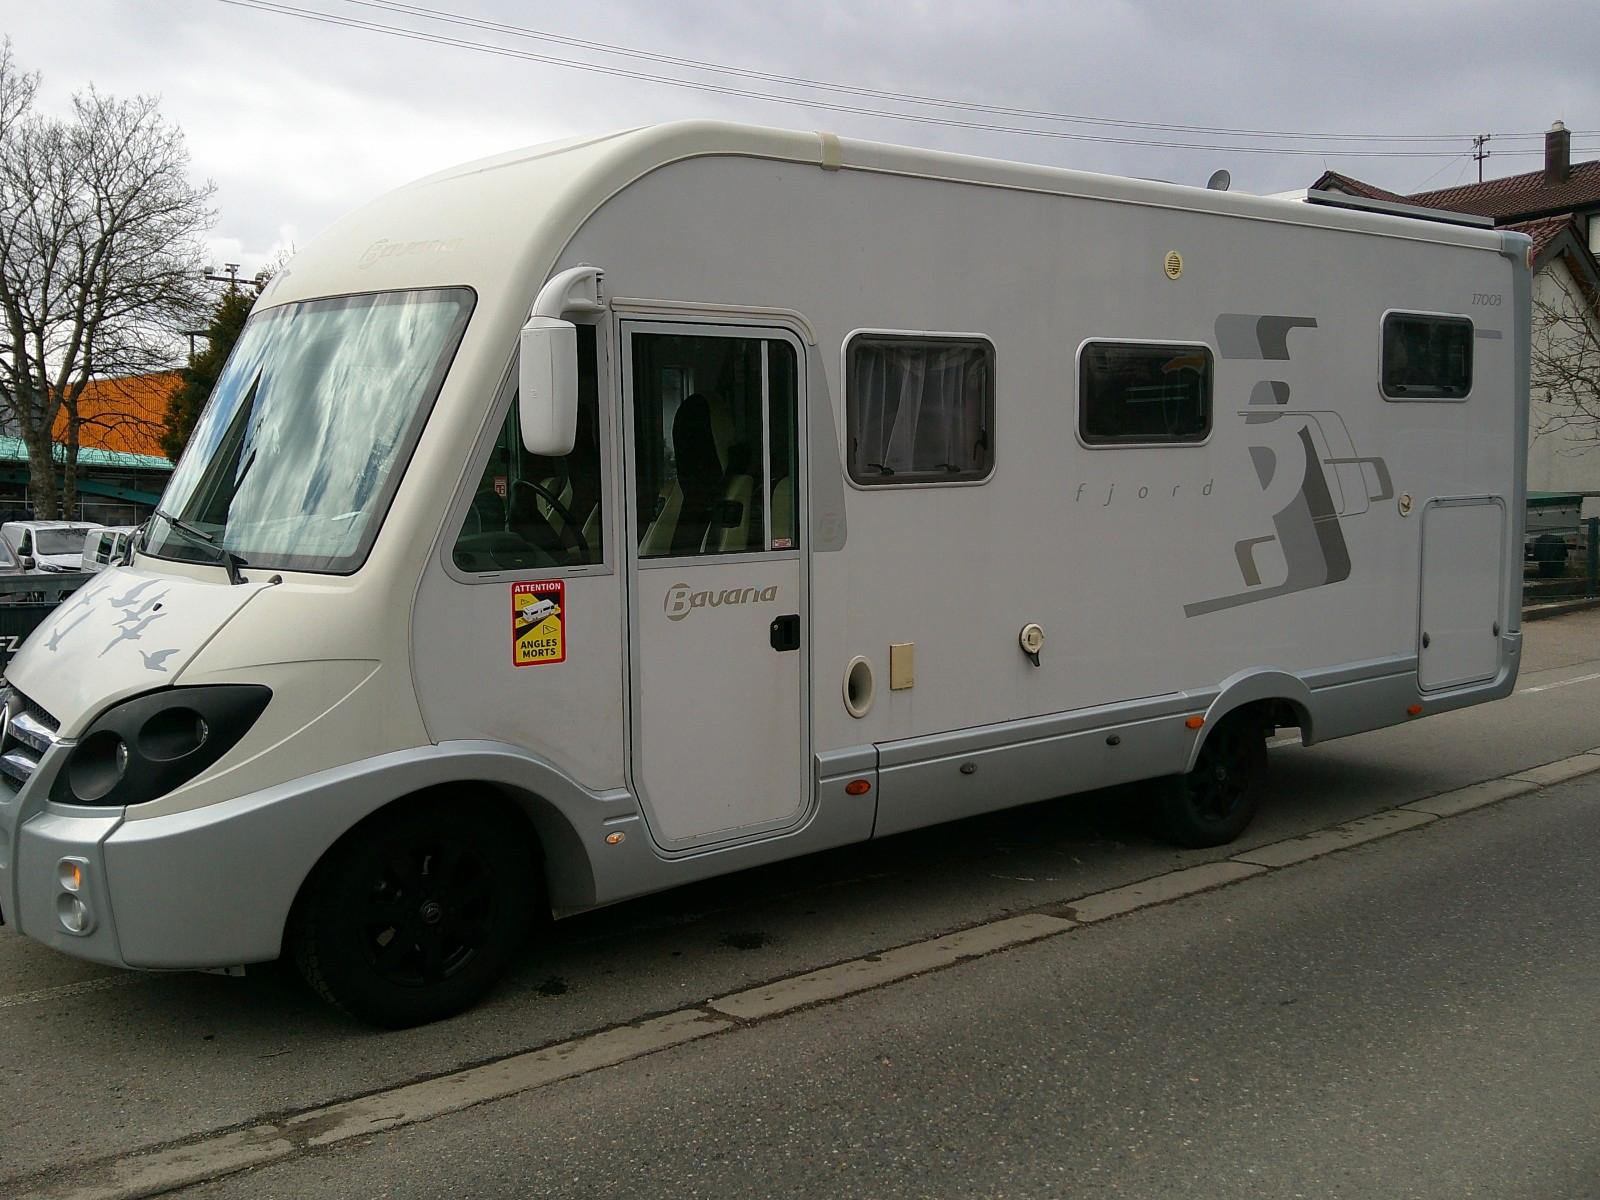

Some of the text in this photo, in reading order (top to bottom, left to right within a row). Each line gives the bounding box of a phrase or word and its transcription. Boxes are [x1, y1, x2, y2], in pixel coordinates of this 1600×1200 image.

[1075, 478, 1214, 507] fjord
[514, 582, 561, 593] ATTENTION
[663, 582, 778, 622] Bavaria
[520, 638, 558, 650] ANGLES
[522, 647, 556, 659] MORTS
